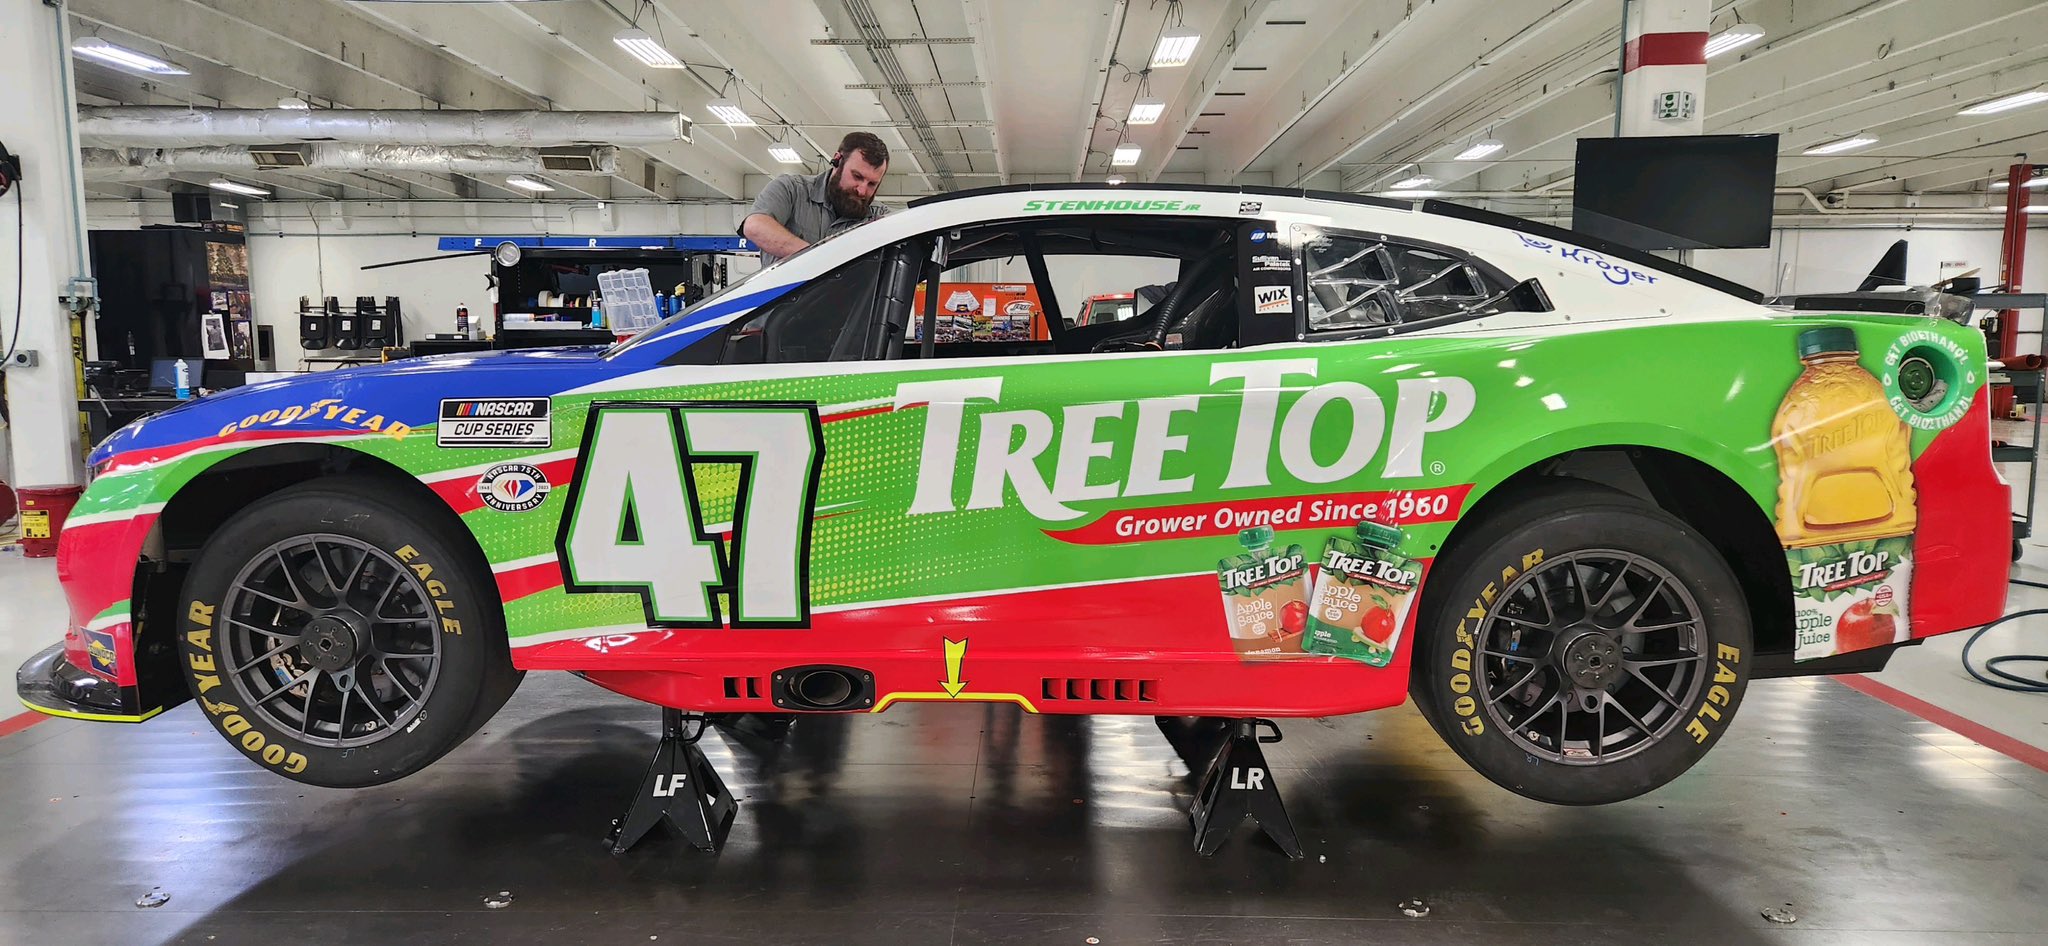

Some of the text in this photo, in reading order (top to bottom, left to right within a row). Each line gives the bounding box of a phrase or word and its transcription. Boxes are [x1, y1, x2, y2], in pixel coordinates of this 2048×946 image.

[1023, 199, 1201, 211] STENHOUSE JR
[474, 238, 482, 247] F
[589, 238, 597, 247] R
[739, 238, 747, 248] R
[1561, 247, 1658, 285] Kroger
[1258, 288, 1288, 304] WIX
[1885, 330, 1969, 366] GET BIOETHANOL
[475, 402, 534, 416] NASCAR
[1890, 396, 1973, 430] GET BIOETHANOL
[454, 423, 535, 436] CUP SERIES
[893, 358, 1477, 522] TREE TOP
[487, 465, 541, 480] NASCAR 75TH
[485, 493, 543, 511] ANNIVERSARY
[557, 402, 823, 627] 47
[1115, 494, 1449, 537] Grower Owned Since 1960
[1223, 567, 1267, 589] TREE
[1265, 554, 1303, 578] TOP
[1326, 549, 1377, 574] TREE
[1372, 559, 1416, 586] TOP
[1798, 560, 1847, 590] TREE
[1847, 550, 1889, 577] TOP
[394, 543, 463, 636] EAGLE
[1321, 584, 1361, 603] Apple
[1236, 598, 1273, 616] Apple
[1319, 593, 1358, 612] Sauce
[1237, 610, 1275, 627] Sauce
[1795, 632, 1831, 650] Juice
[1685, 641, 1741, 744] EAGLE
[653, 774, 687, 797] LF
[1231, 767, 1265, 790] LR
